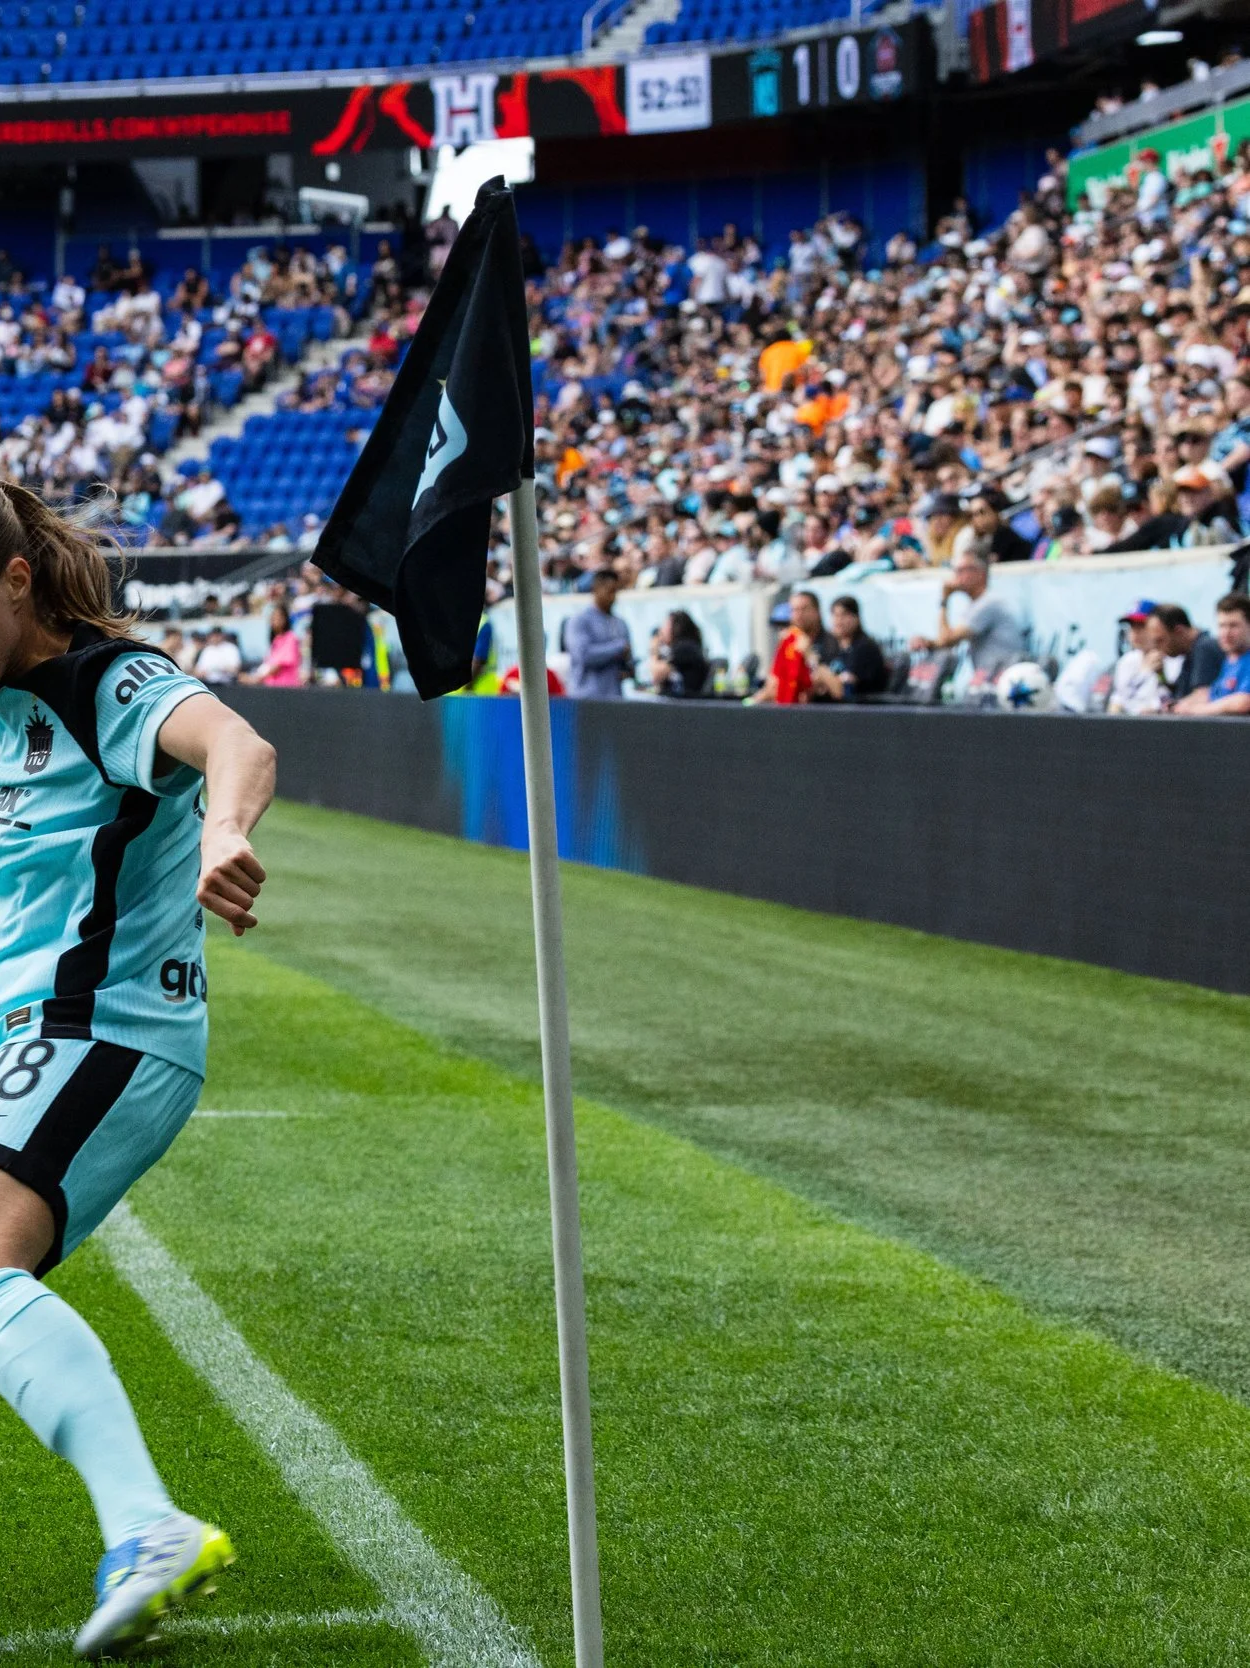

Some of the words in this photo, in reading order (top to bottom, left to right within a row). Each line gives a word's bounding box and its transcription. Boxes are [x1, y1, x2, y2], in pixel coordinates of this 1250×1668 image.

[793, 44, 811, 106] 1
[836, 36, 860, 99] 0
[115, 659, 176, 706] ally
